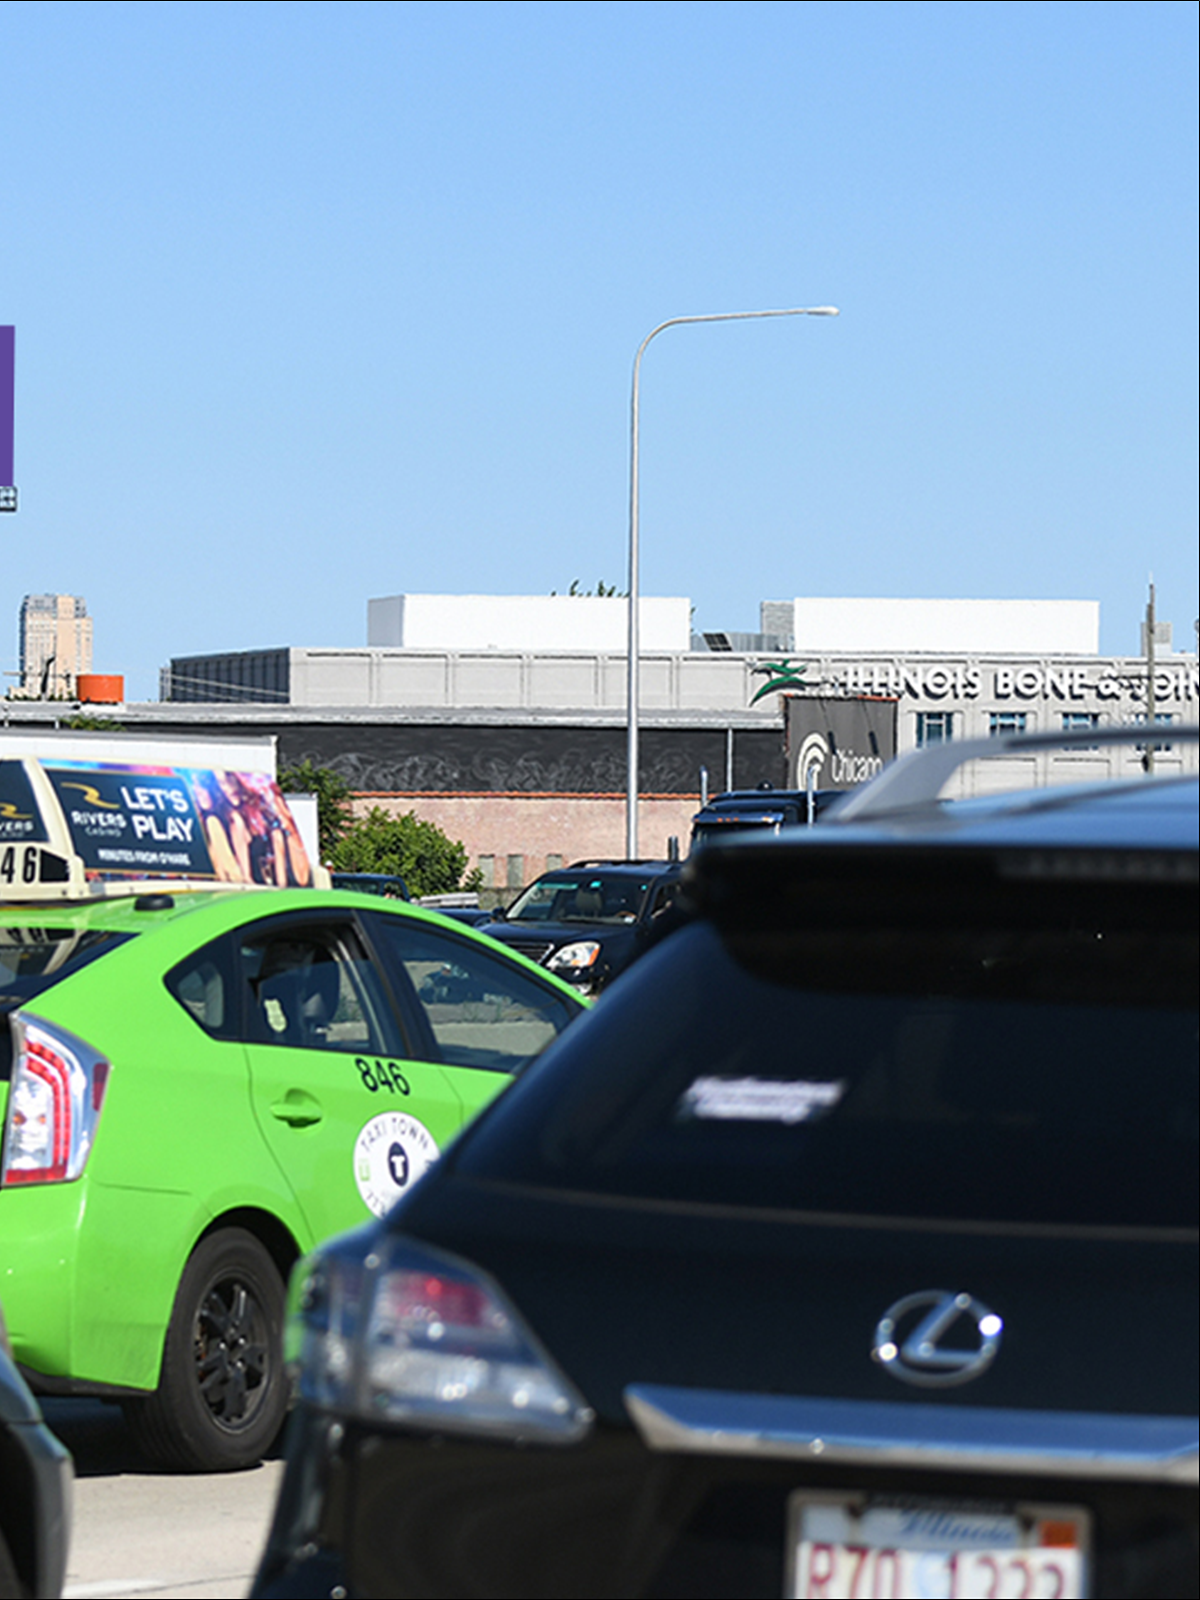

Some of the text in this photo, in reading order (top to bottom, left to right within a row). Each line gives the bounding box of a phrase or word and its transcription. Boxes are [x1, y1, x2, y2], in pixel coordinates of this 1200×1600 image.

[844, 666, 982, 698] ILLINOIS
[996, 668, 1088, 699] BONE
[121, 786, 189, 812] LET'S
[71, 810, 127, 829] RIVERS
[132, 815, 193, 842] PLAY
[355, 1057, 411, 1096] 846
[391, 1116, 431, 1150] TOWN
